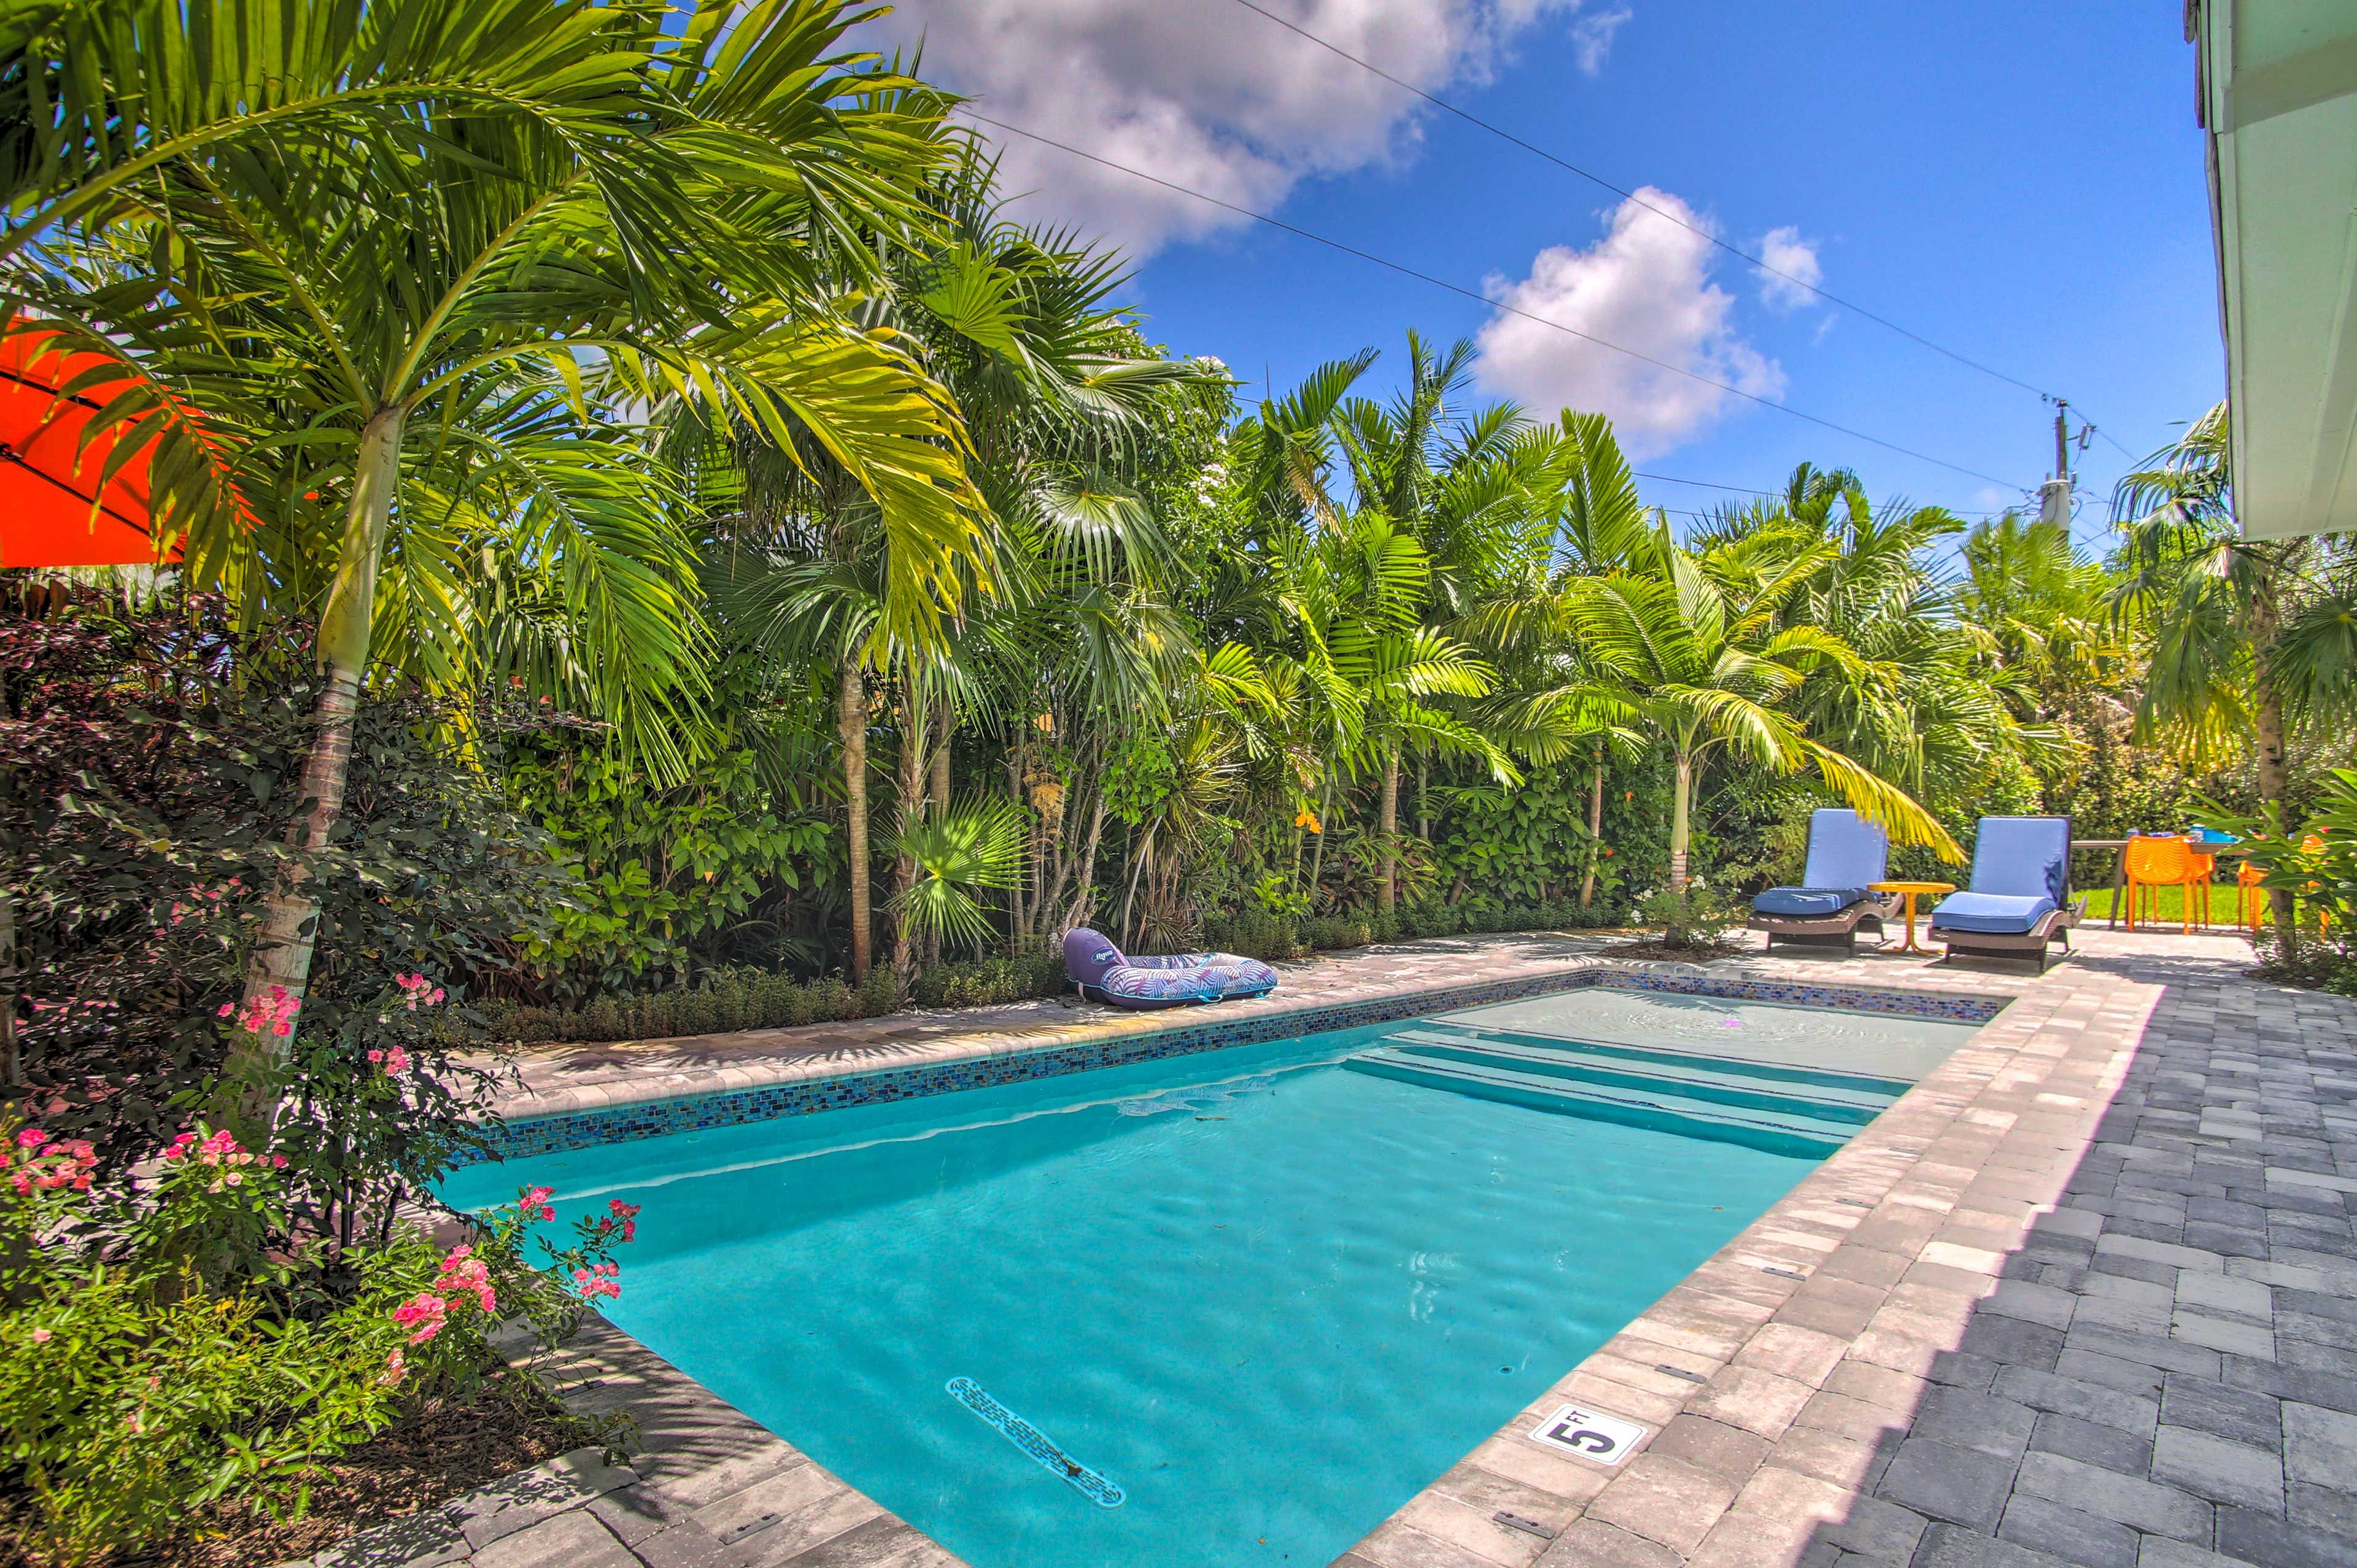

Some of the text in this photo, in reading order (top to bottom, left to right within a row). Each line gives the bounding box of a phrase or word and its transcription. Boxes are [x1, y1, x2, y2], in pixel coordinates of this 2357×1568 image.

[1094, 949, 1113, 961] Aqua
[1546, 1410, 1616, 1453] 5 FT
